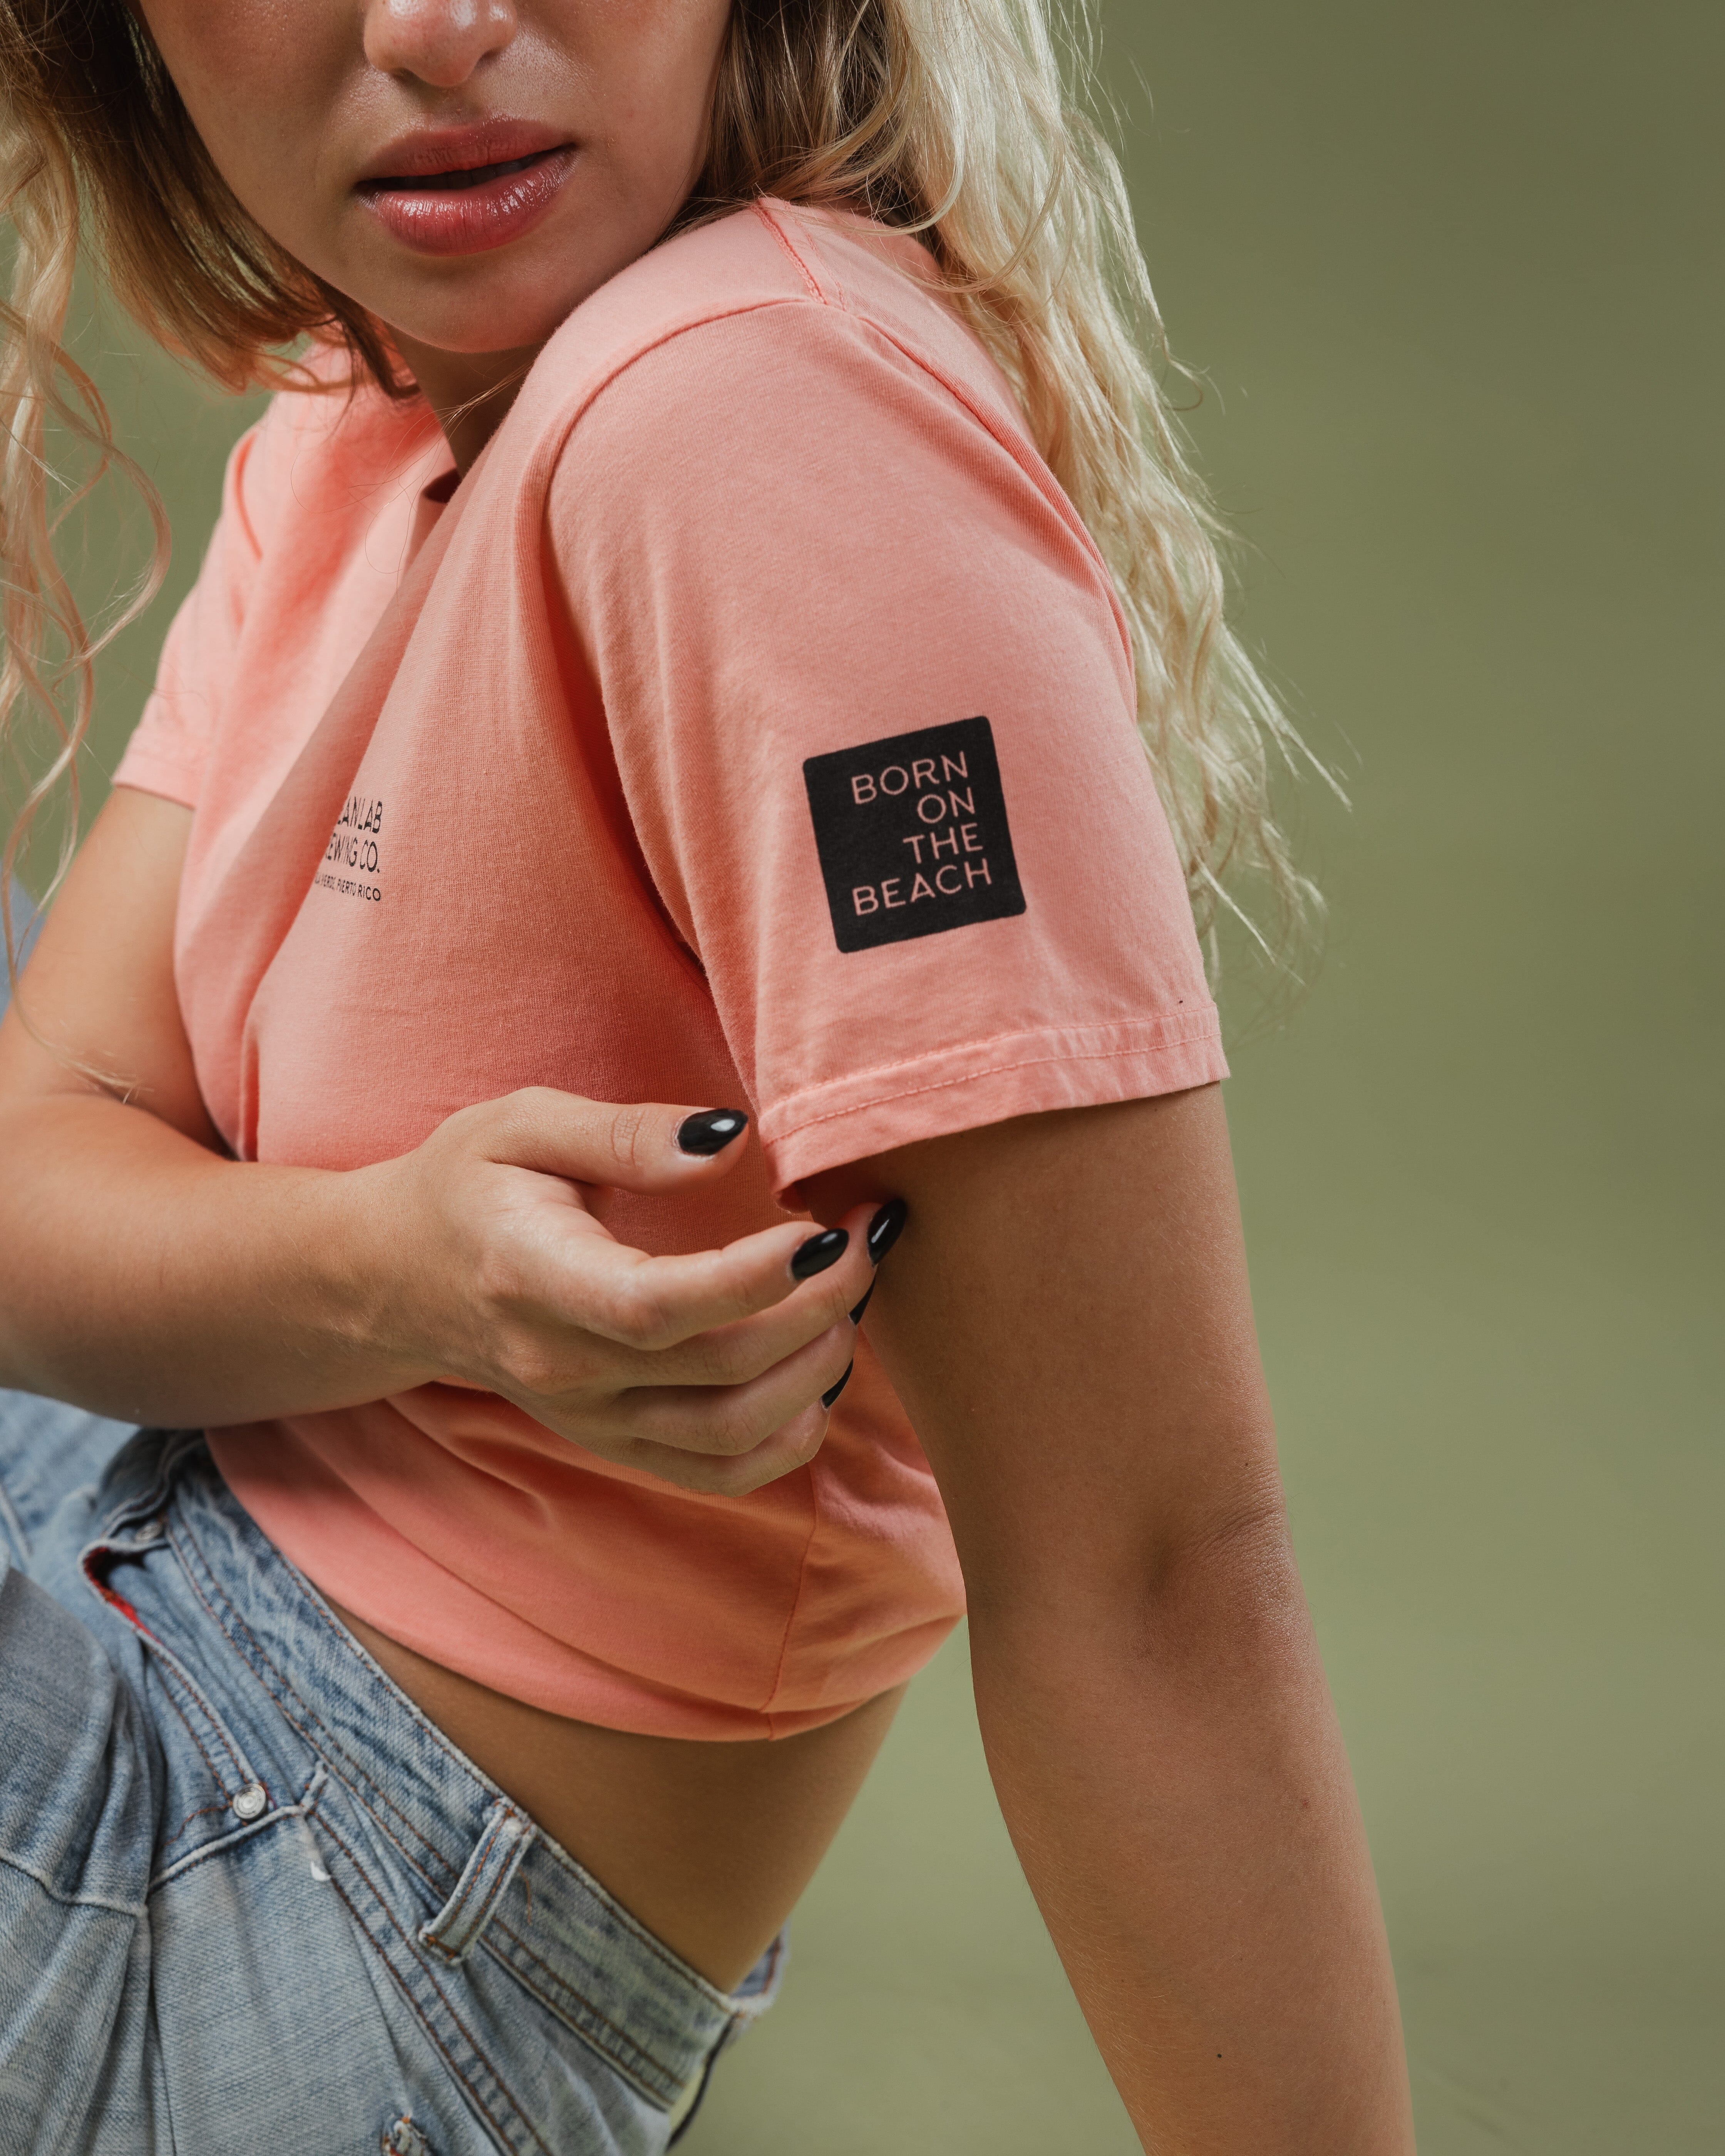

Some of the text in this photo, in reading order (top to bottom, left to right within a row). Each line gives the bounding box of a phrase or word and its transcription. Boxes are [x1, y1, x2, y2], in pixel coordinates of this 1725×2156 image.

[851, 750, 968, 805] BORN
[337, 796, 382, 834] ANLAB
[916, 786, 976, 824] ON
[325, 832, 380, 874] EWING CO.
[902, 822, 983, 864] THE
[357, 884, 381, 902] RICO
[851, 857, 992, 916] BEACH
